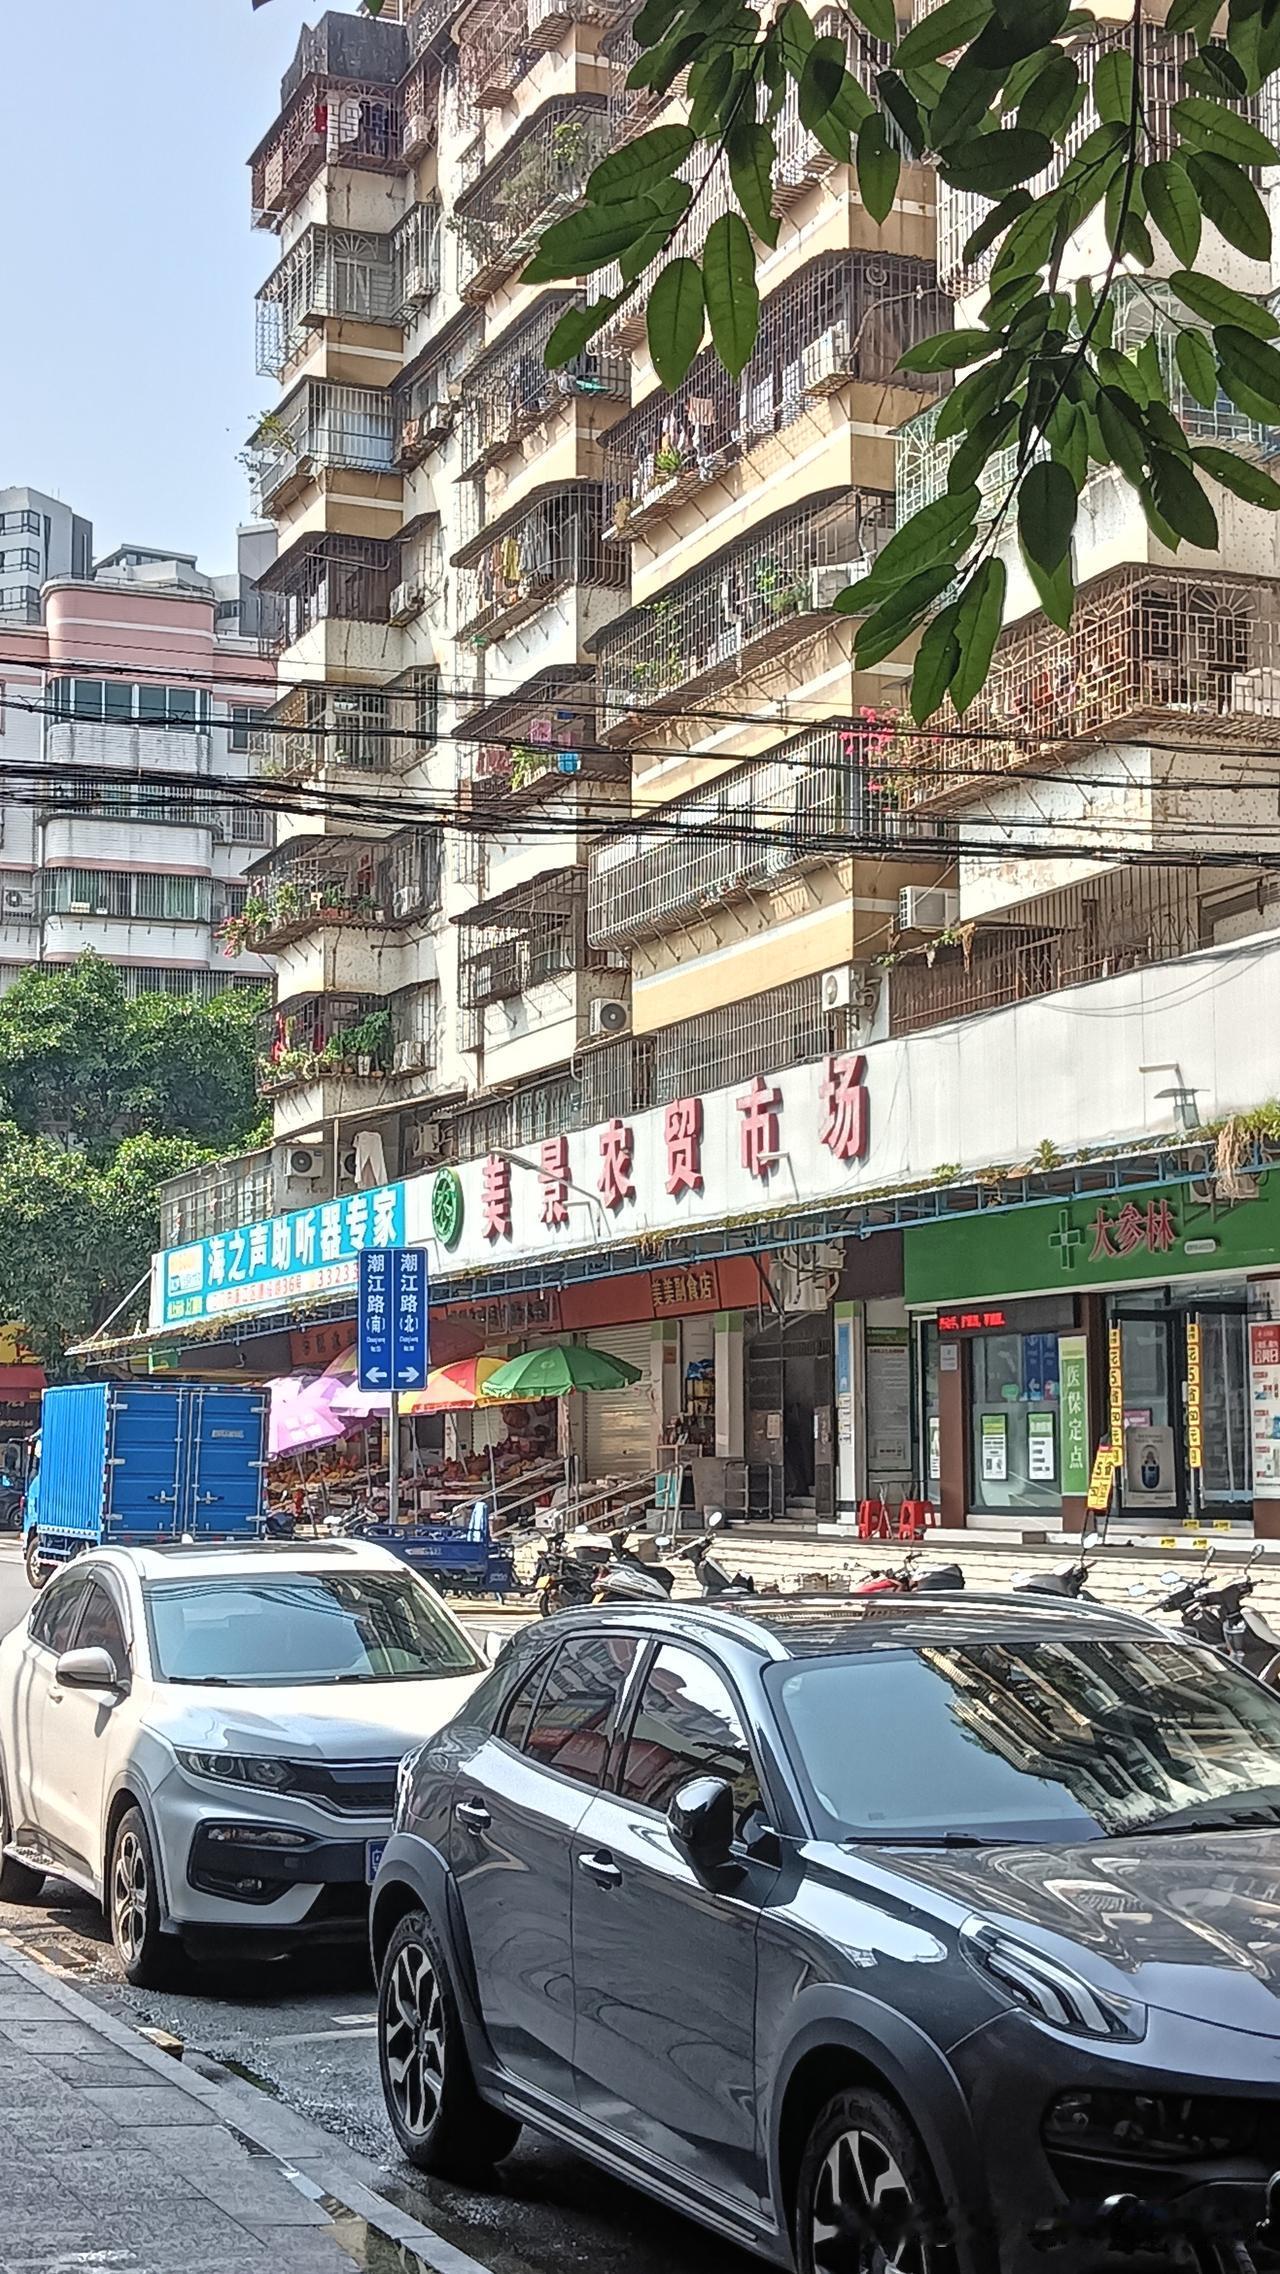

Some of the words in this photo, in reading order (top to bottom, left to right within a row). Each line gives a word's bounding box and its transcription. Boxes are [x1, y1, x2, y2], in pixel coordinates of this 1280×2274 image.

[482, 1055, 866, 1239] 美景农贸市场
[208, 1190, 397, 1288] 海之声助听器专家
[1087, 1199, 1175, 1262] 大参林
[651, 1271, 713, 1307] 美美副食店
[1066, 1363, 1085, 1470] 医保定点
